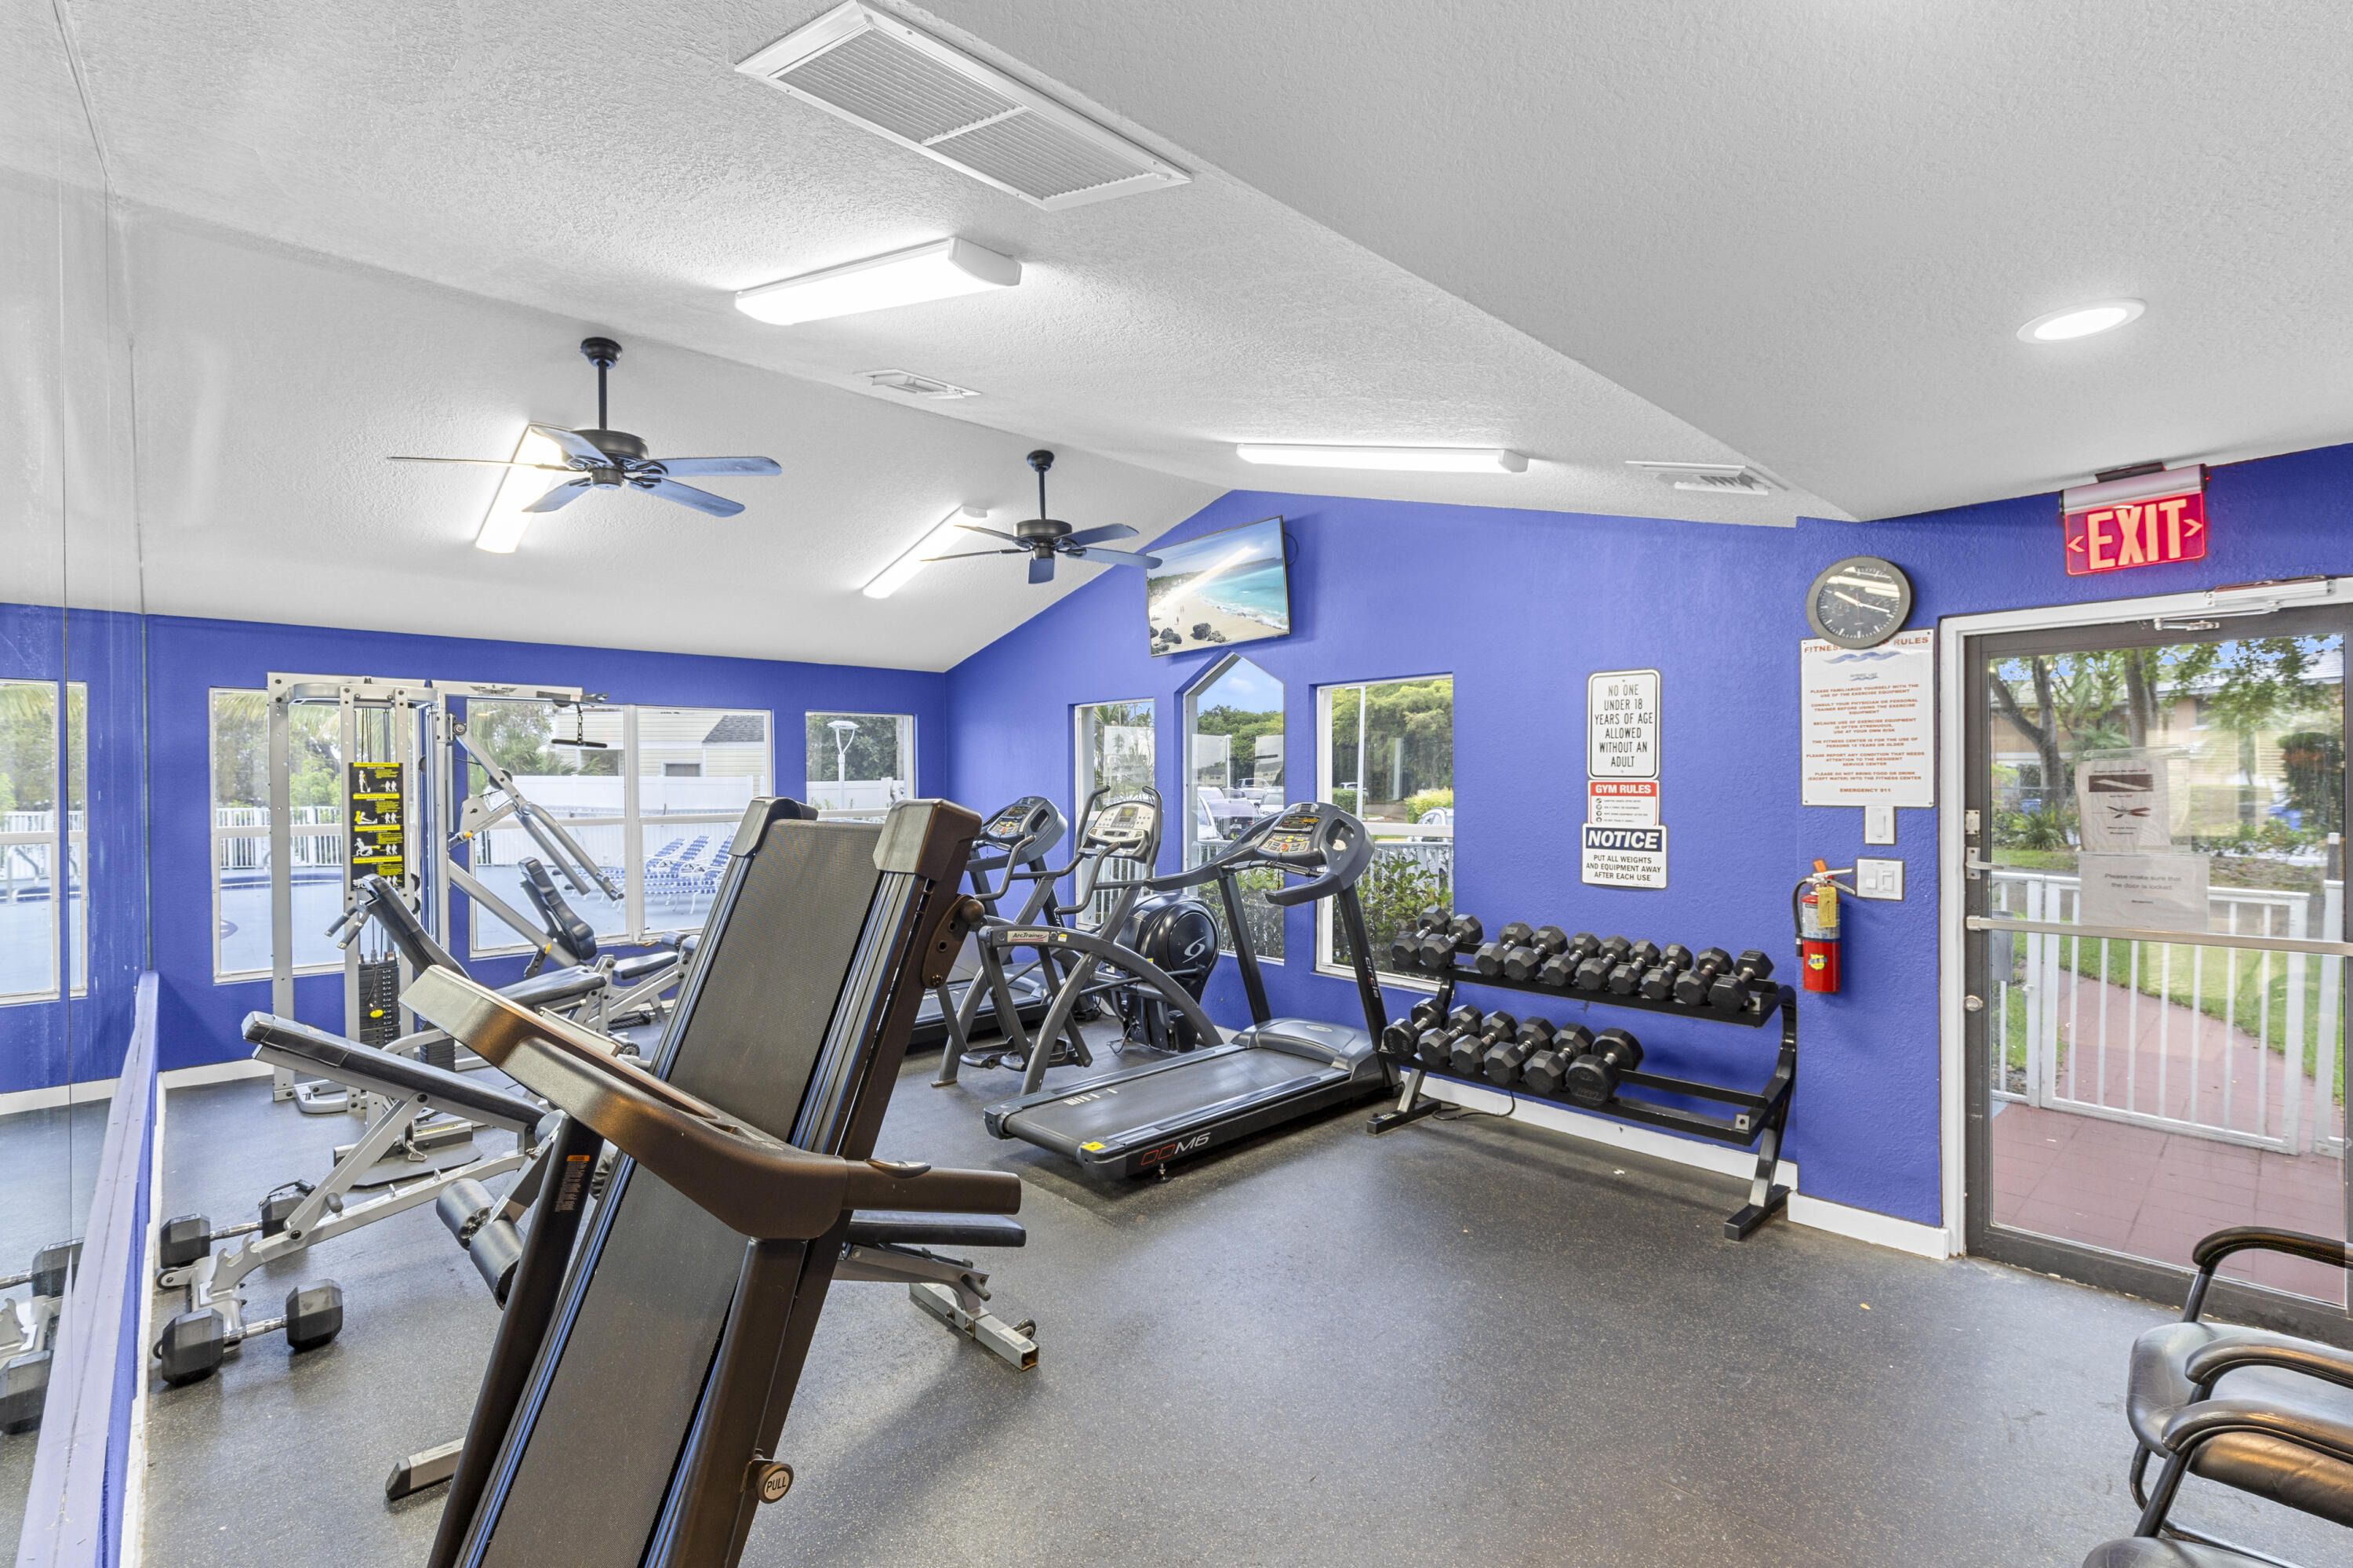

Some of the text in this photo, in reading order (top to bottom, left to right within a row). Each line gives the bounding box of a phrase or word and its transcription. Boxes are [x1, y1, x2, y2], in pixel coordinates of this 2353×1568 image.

[2087, 499, 2187, 569] EXIT
[1893, 637, 1929, 646] RULES
[1609, 684, 1638, 697] NO ONE
[1604, 698, 1642, 711] UNDER 18
[1595, 712, 1653, 725] YEARS OF AGE
[1606, 728, 1641, 738] ALLOWED
[1599, 742, 1647, 753] WITHOUT AN
[1611, 756, 1635, 766] ADULT
[1595, 784, 1651, 793] GYM RULES
[1587, 831, 1659, 849] NOTICE
[766, 1477, 787, 1493] PULL
